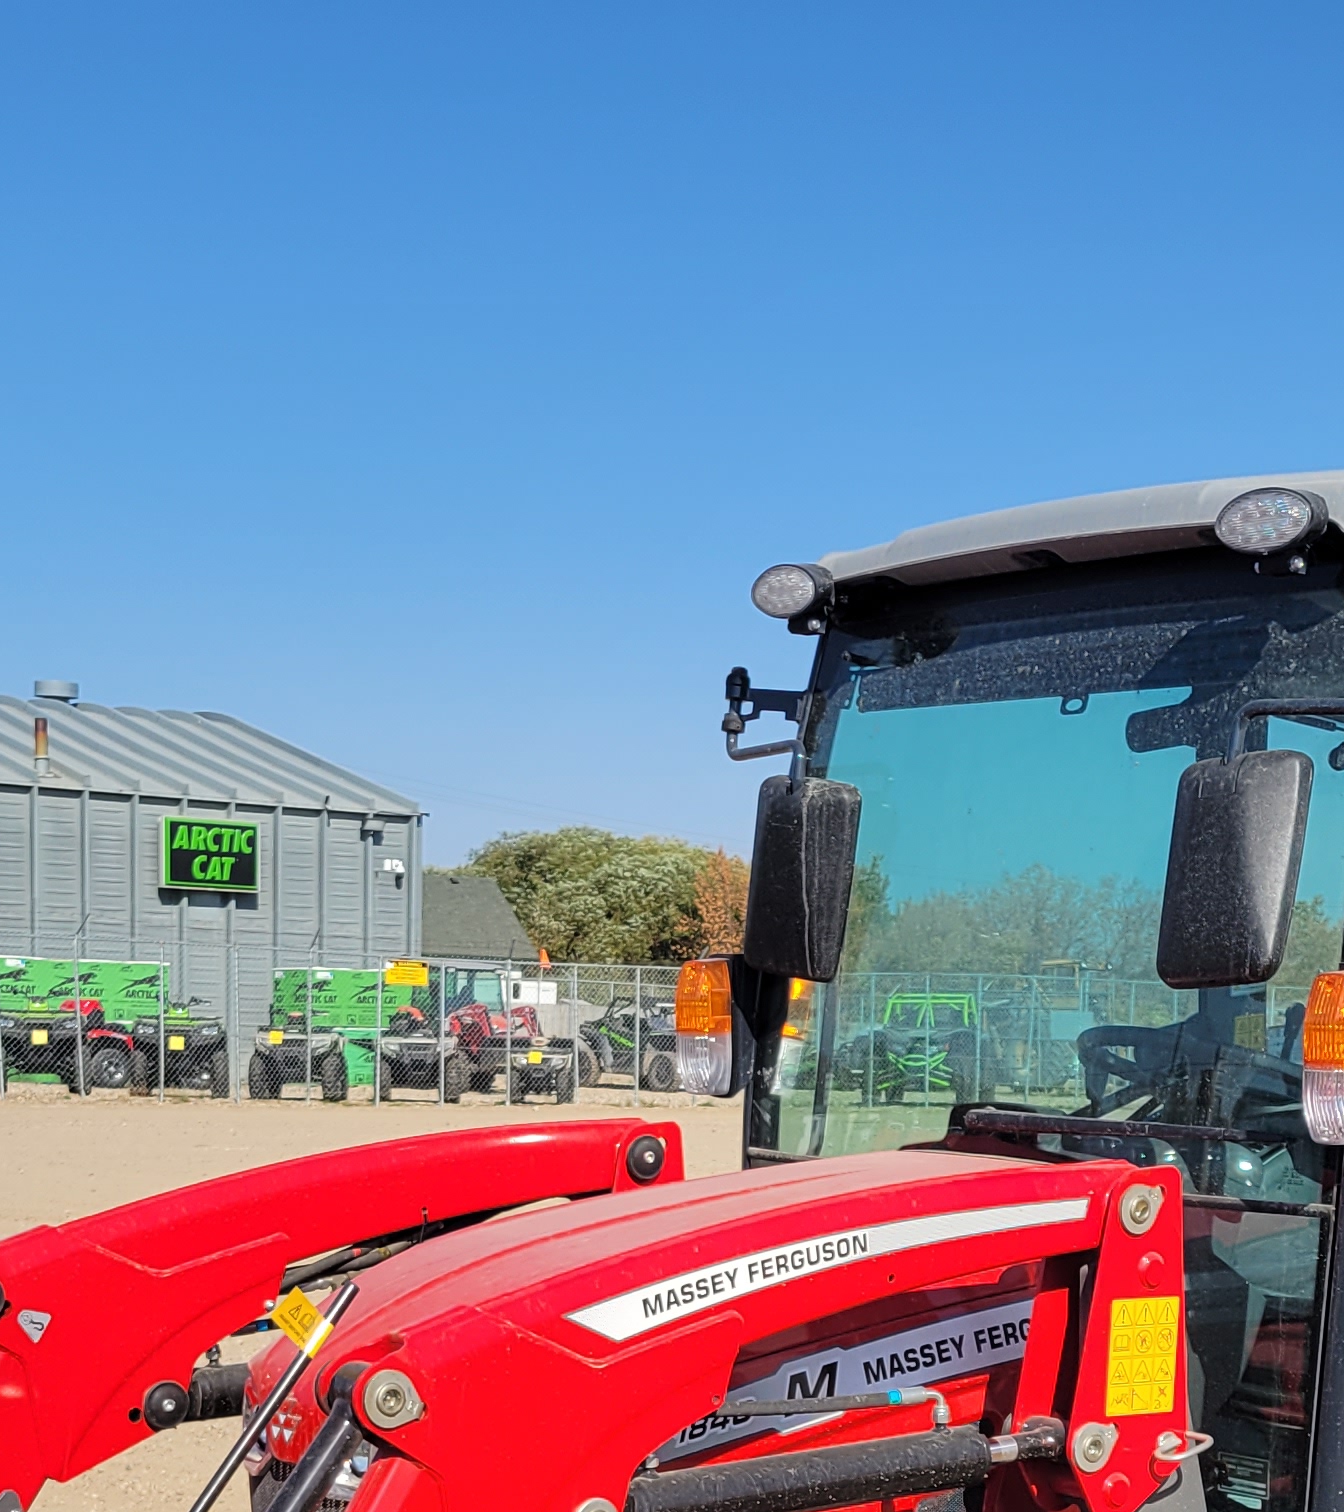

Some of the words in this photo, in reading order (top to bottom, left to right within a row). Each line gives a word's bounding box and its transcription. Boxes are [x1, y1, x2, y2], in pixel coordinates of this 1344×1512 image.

[172, 825, 254, 854] ARCTIC
[191, 854, 236, 881] CAT
[641, 1267, 738, 1319] MASSEY
[747, 1232, 869, 1284] FERGUSON
[862, 1334, 966, 1386] MASSEY
